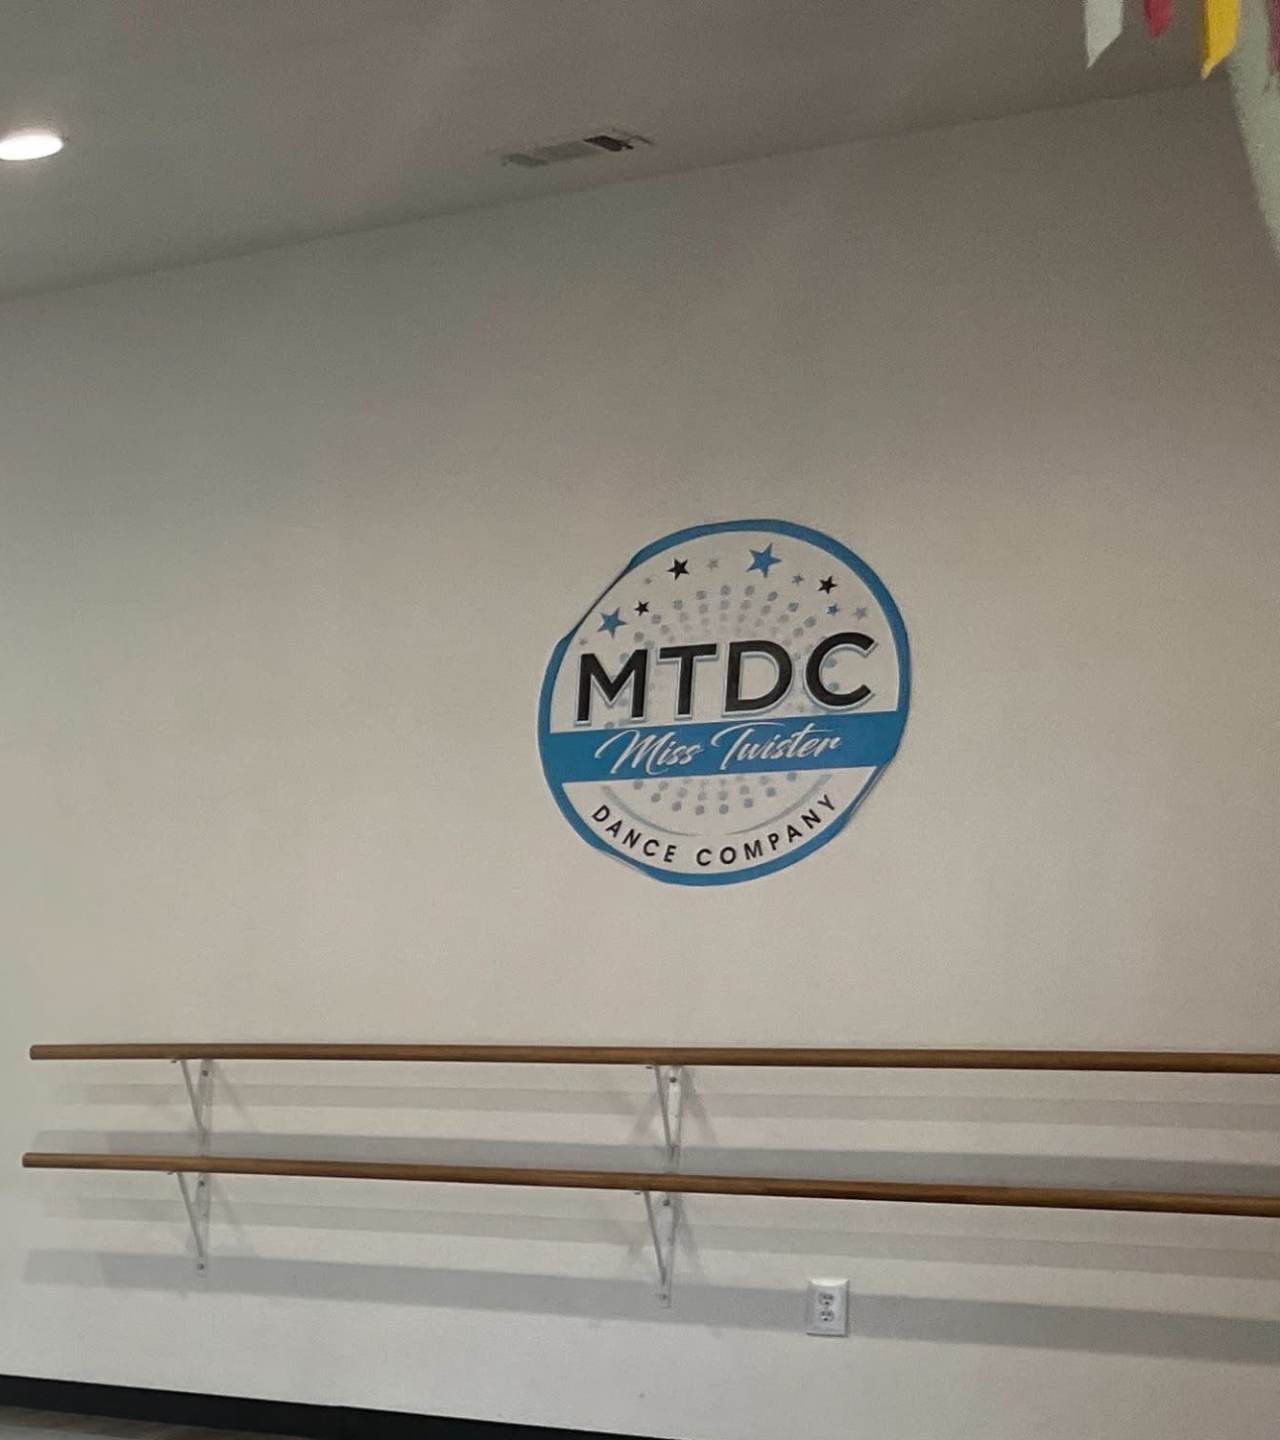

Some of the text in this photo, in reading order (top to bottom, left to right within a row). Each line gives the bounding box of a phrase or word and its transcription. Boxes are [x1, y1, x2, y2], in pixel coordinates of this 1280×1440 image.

[573, 631, 881, 726] MTDC
[594, 721, 842, 777] Miss Twister
[590, 793, 838, 868] DANCE COMPANY
